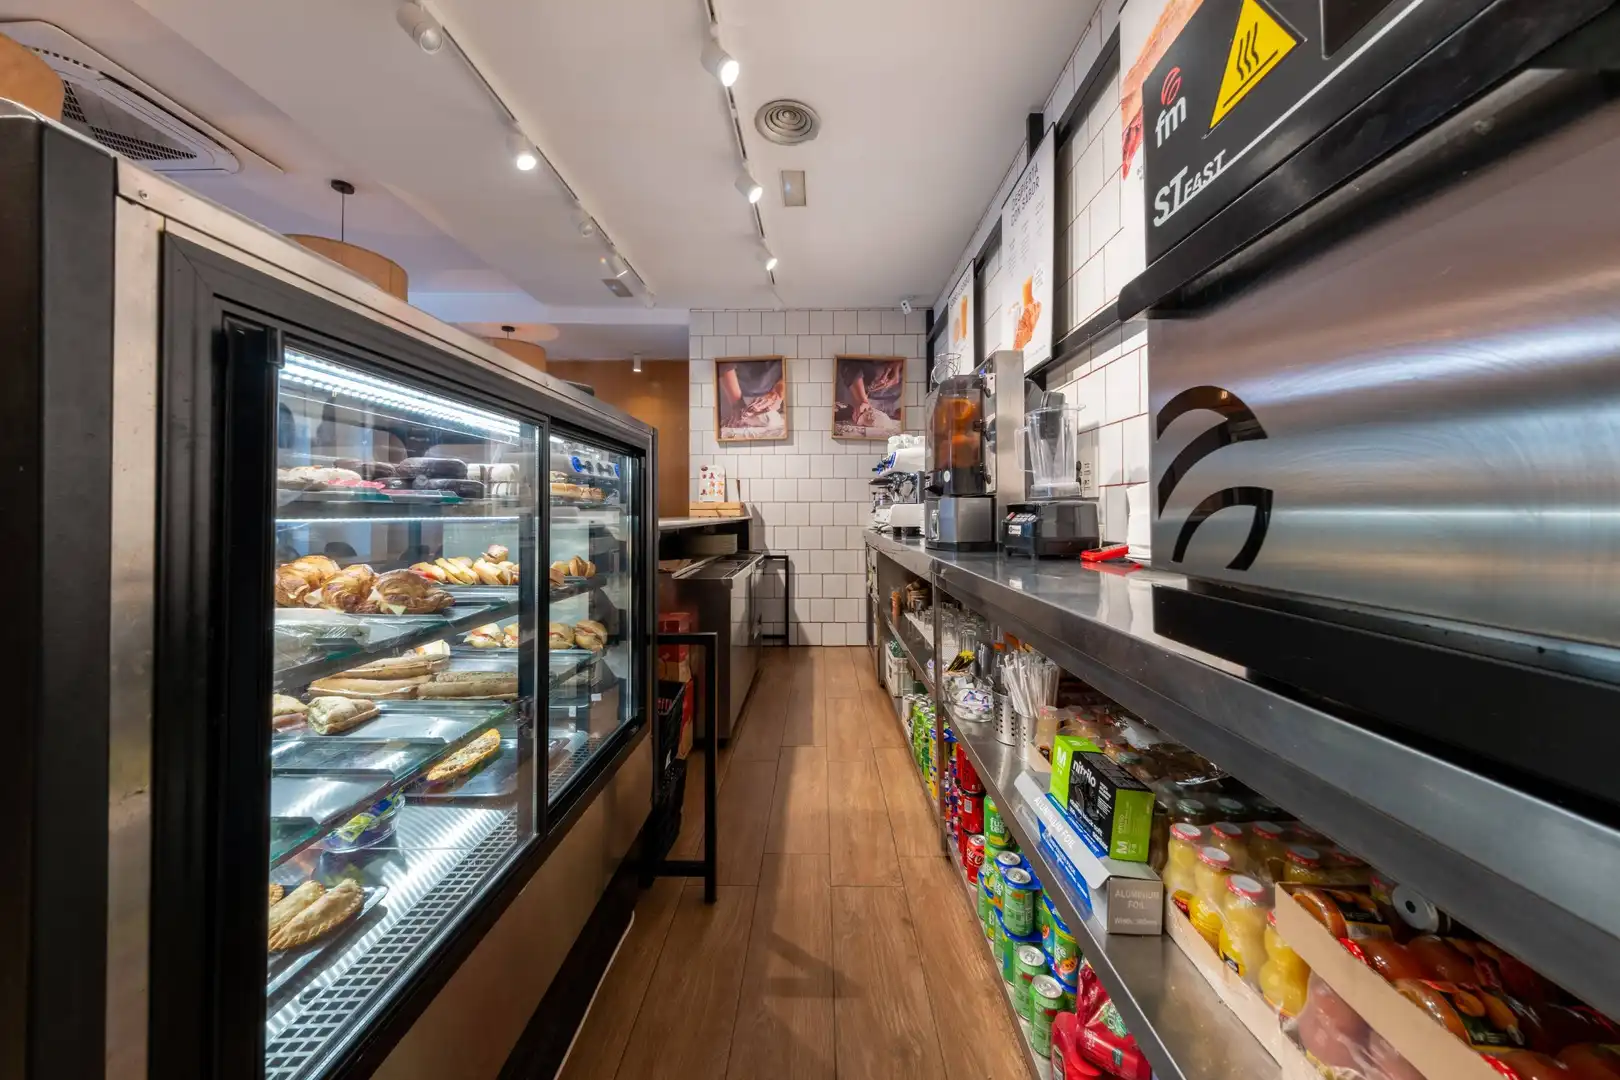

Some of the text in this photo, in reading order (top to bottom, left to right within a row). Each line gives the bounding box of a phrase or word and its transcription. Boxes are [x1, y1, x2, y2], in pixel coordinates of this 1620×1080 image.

[1155, 96, 1187, 148] fm
[1056, 745, 1067, 769] M
[1072, 759, 1097, 788] nitrilo
[1034, 796, 1065, 834] ALUMINIUM
[1061, 829, 1077, 851] FOIL
[1114, 889, 1160, 900] ALUMINIUM
[1127, 899, 1145, 910] FOIL
